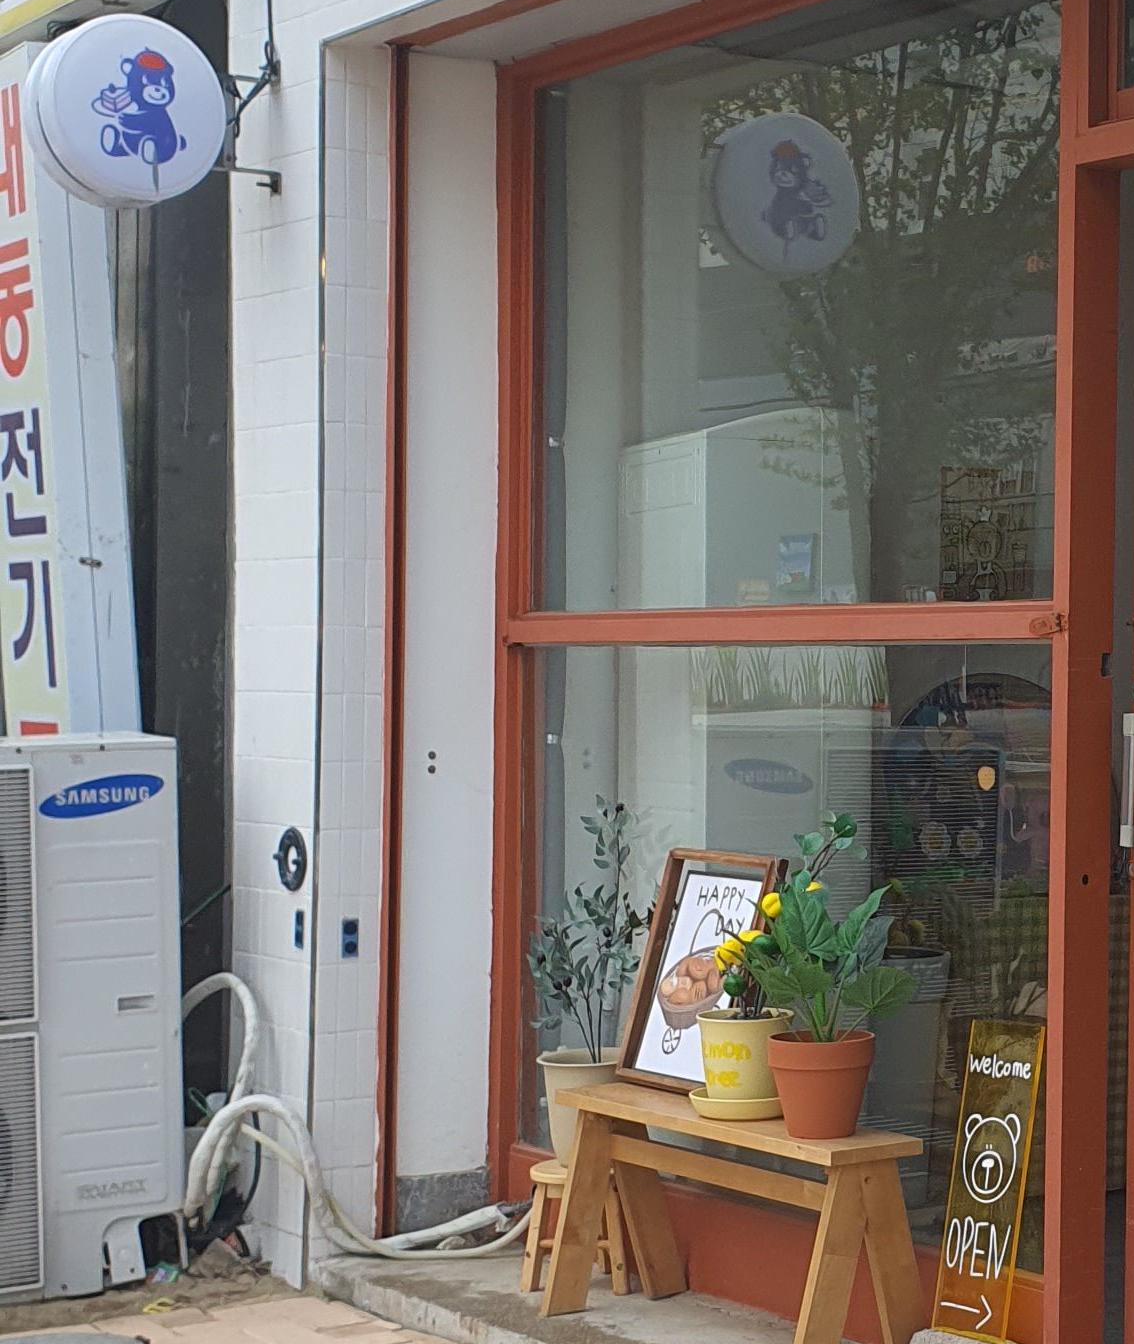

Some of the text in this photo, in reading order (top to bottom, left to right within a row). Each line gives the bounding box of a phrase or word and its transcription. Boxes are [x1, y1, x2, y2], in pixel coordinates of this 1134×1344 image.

[55, 785, 150, 806] SAMSUNG
[697, 884, 746, 911] HAPPY
[970, 1054, 1032, 1080] welcome
[946, 1216, 1012, 1279] OPEN
